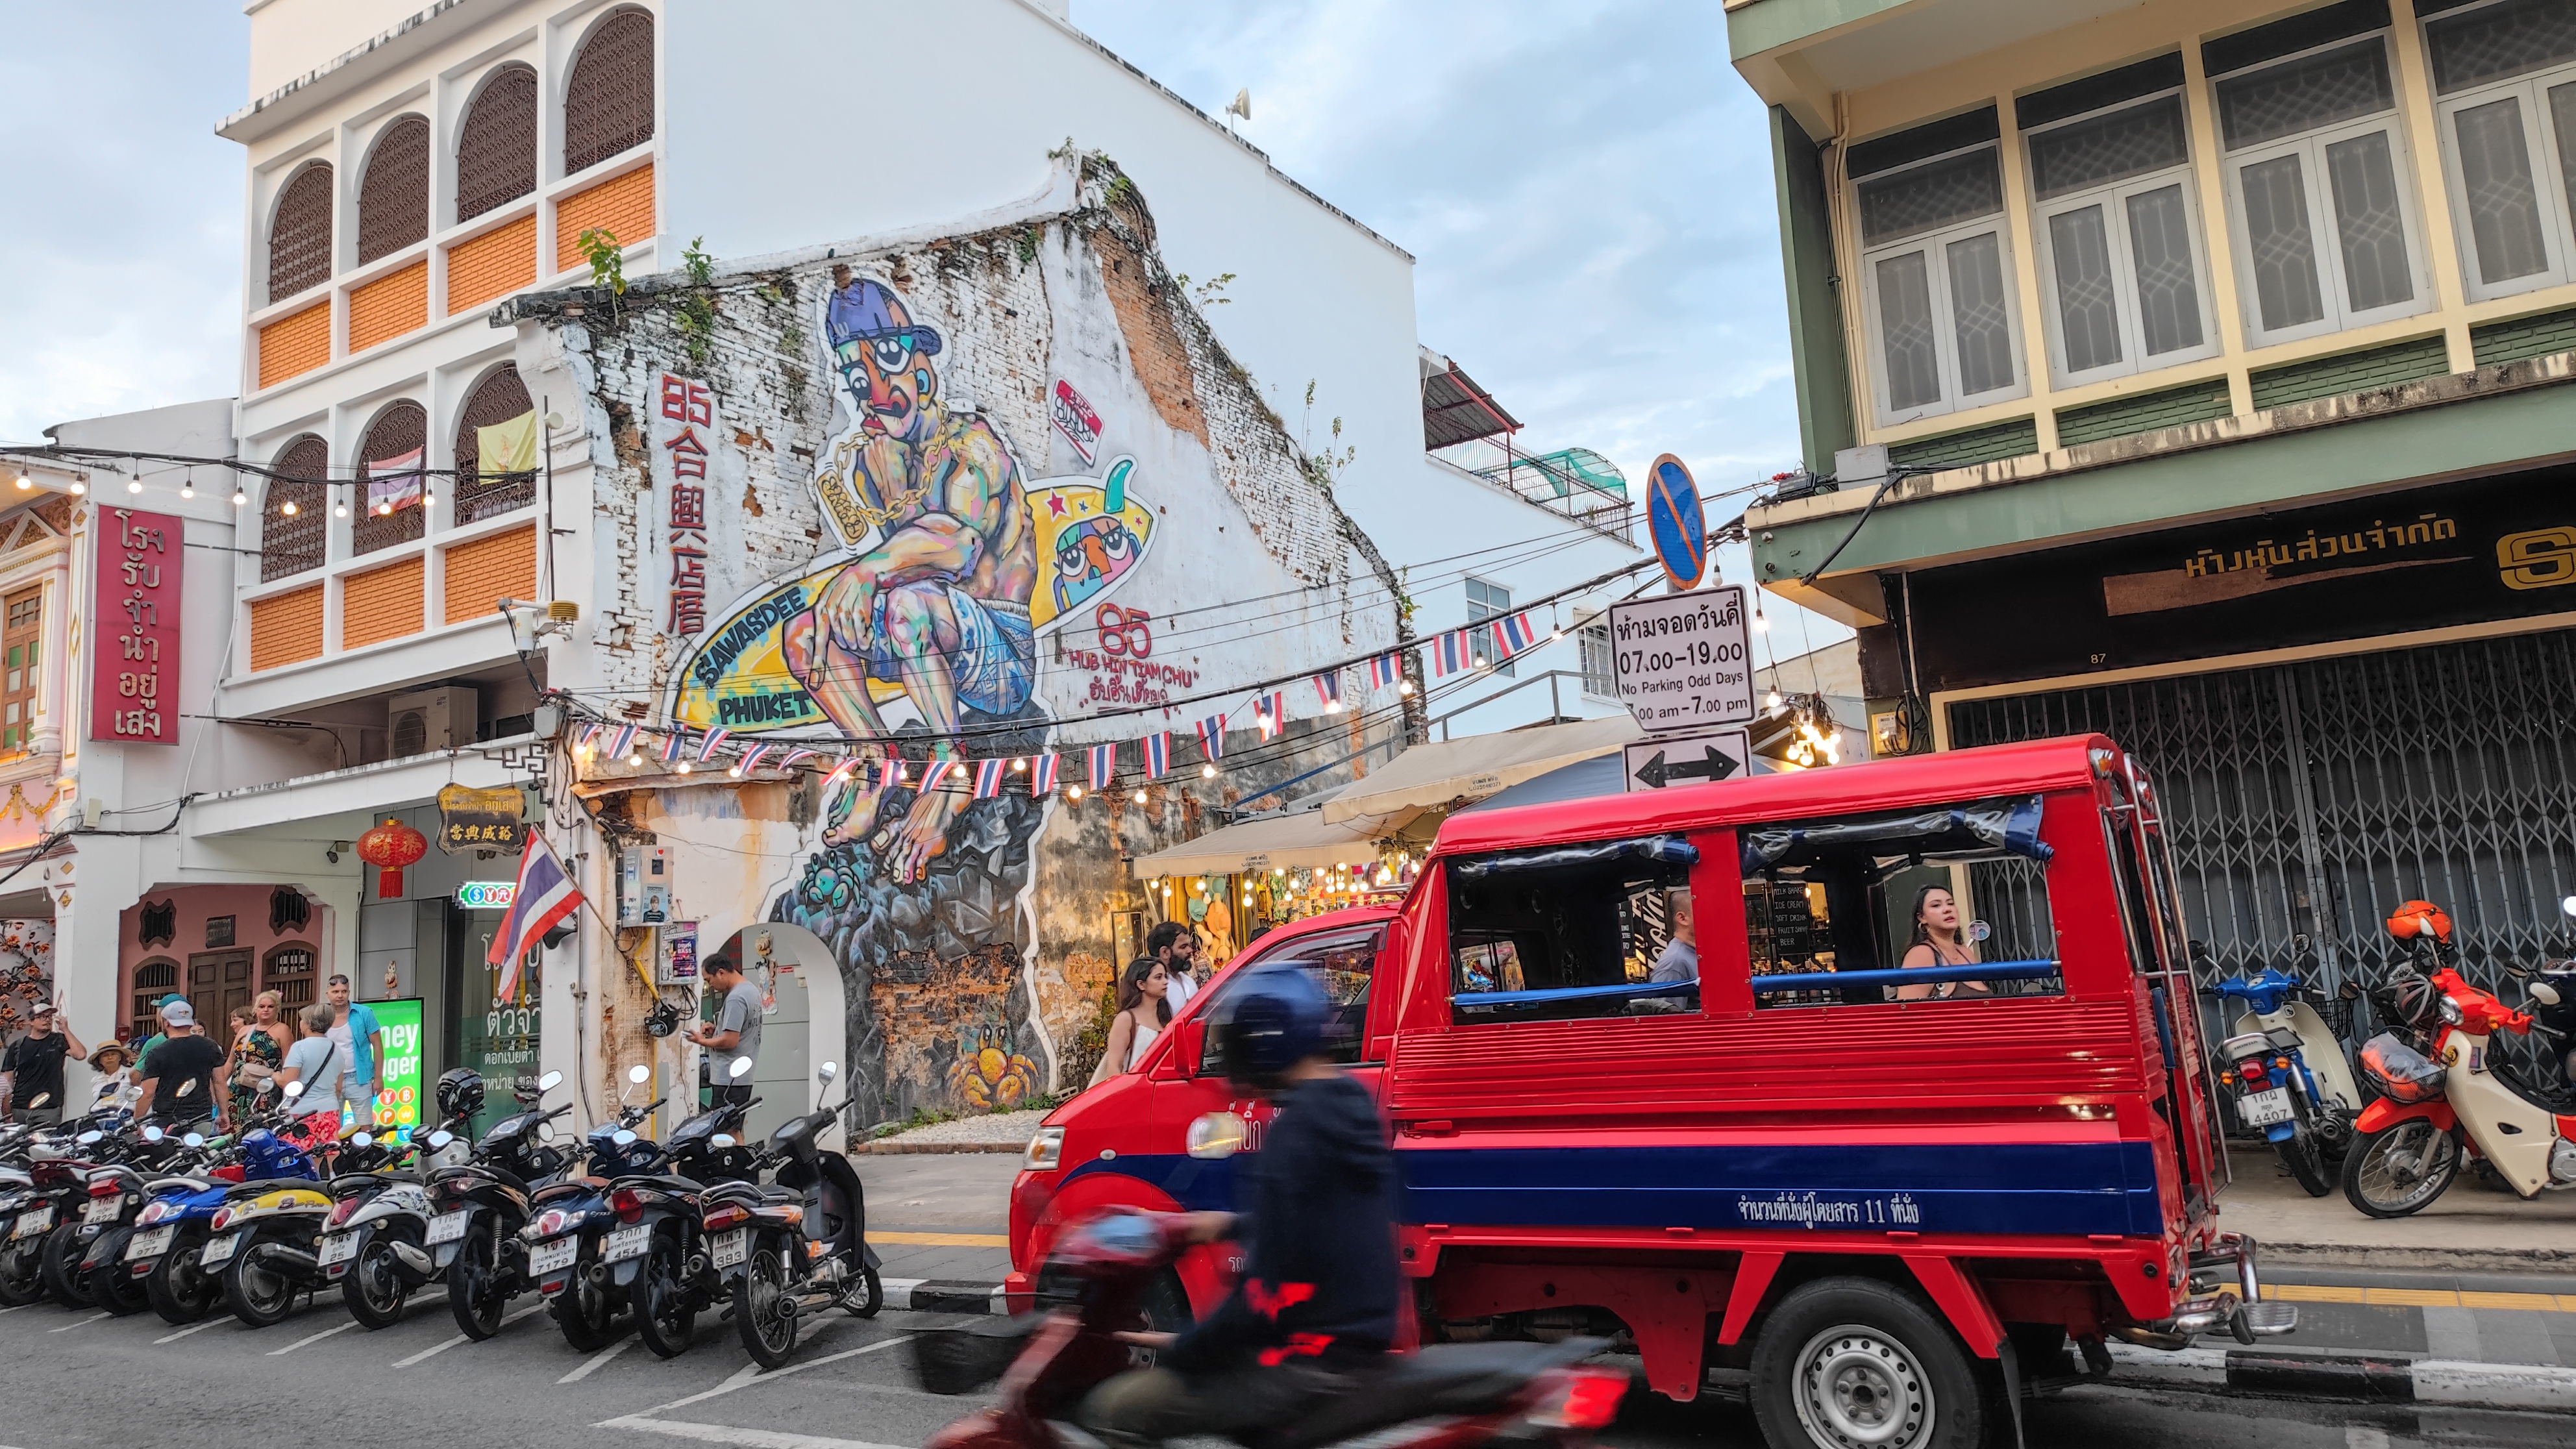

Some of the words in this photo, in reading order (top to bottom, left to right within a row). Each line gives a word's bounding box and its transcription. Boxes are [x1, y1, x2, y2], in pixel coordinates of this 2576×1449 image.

[662, 372, 711, 428] 85
[1616, 592, 1740, 641] ห้ามจอดวันคี่
[695, 586, 806, 689] SAWASDEE
[1096, 602, 1152, 659] 85
[2090, 653, 2106, 663] 87
[1102, 654, 1127, 675] HIN
[1128, 660, 1161, 681] TIAM
[1622, 683, 1637, 695] No
[1642, 678, 1683, 694] Parking
[1688, 673, 1711, 688] Odd
[1716, 671, 1744, 686] Days
[719, 690, 811, 725] PHUKET
[1727, 699, 1748, 713] pm
[1780, 937, 1795, 946] BEER
[484, 1039, 534, 1065] ดอกเบี้ยต่ำ
[2234, 1040, 2259, 1050] HONDA
[2254, 1109, 2288, 1124] 4407
[1738, 1191, 1859, 1230] จำนวนที่นั่งผู้โดยสาร
[1865, 1199, 1885, 1223] 11
[1890, 1193, 1920, 1224] ที่นั่ง
[429, 1230, 461, 1243] 6891
[136, 1246, 158, 1257] 977
[329, 1253, 344, 1261] 25
[614, 1246, 638, 1260] 454
[716, 1252, 743, 1267] 393
[537, 1257, 569, 1274] 7179
